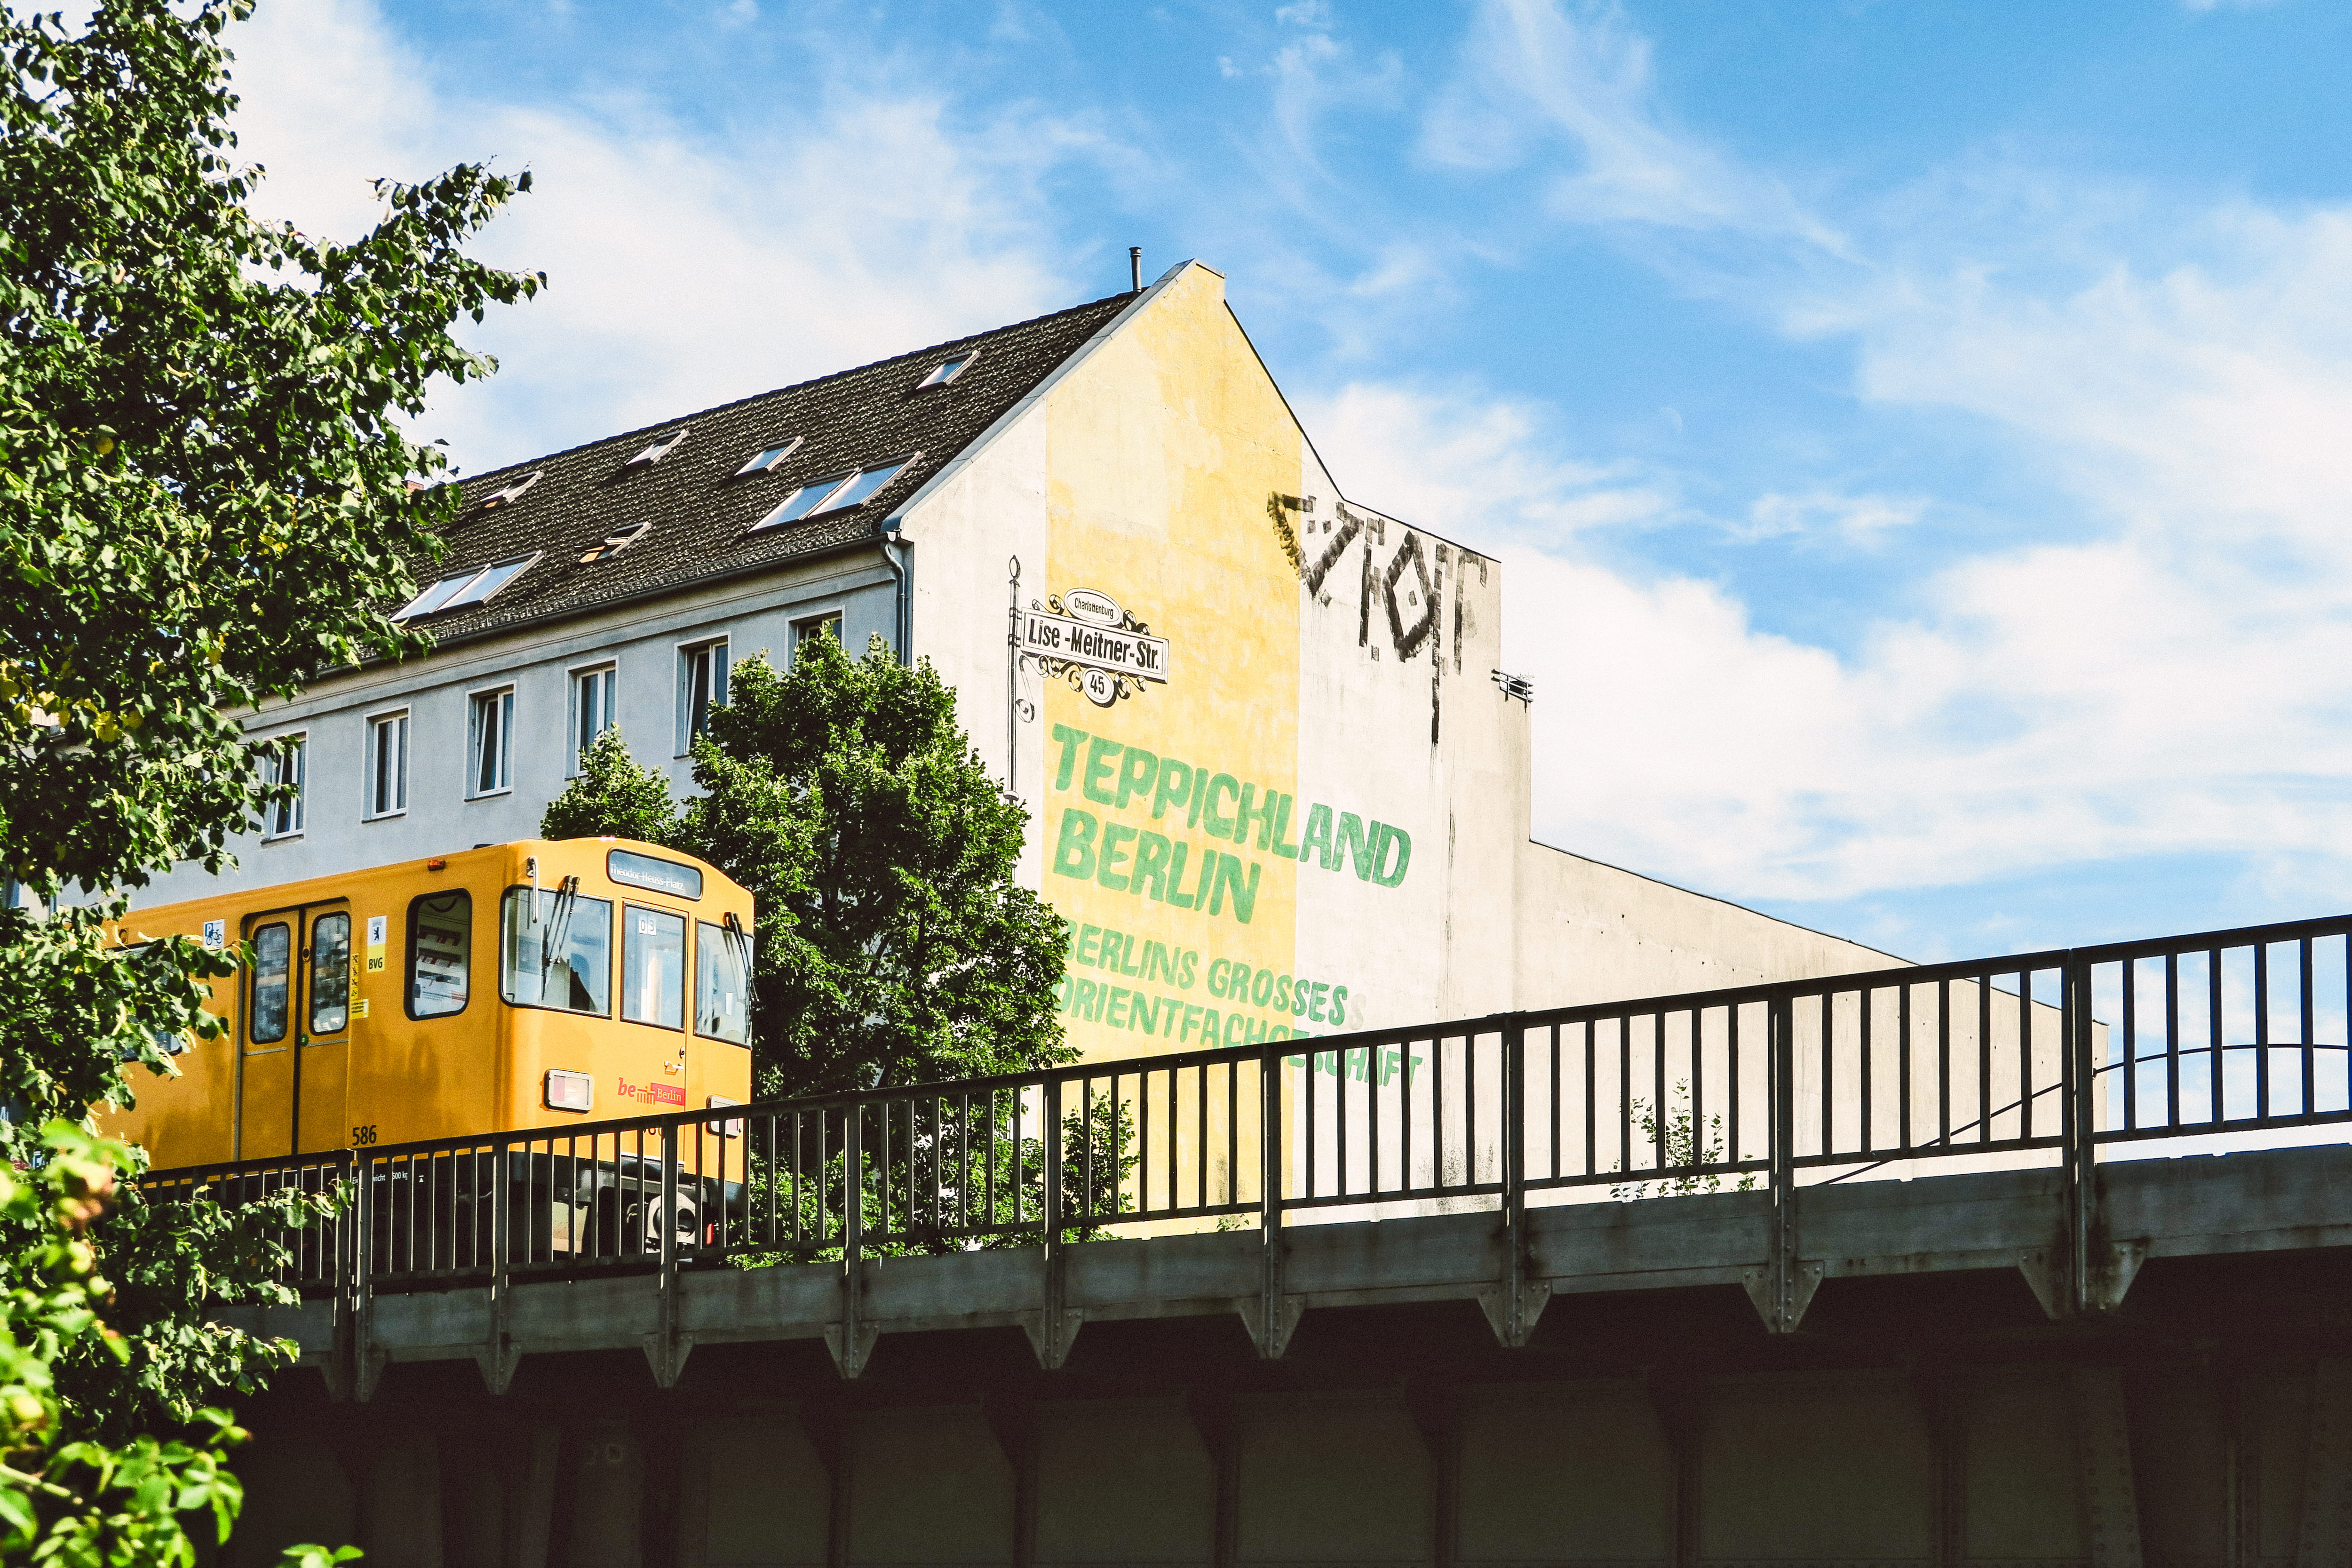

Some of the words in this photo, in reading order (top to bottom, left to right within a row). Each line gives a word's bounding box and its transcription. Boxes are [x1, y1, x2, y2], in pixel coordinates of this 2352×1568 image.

[1074, 597, 1114, 619] Charlottenburg
[1090, 674, 1104, 694] 45
[1052, 723, 1411, 888] TEPPICHLAND
[610, 863, 684, 891] Theodor-Heuss-Platz
[1053, 808, 1262, 924] BERLIN
[641, 919, 654, 931] 03
[368, 957, 383, 969] BVG
[1058, 917, 1198, 990] BERLINS
[1208, 958, 1348, 1026] GROSSES
[618, 1077, 636, 1097] be
[657, 1088, 682, 1102] Berlin
[352, 1125, 377, 1146] 586
